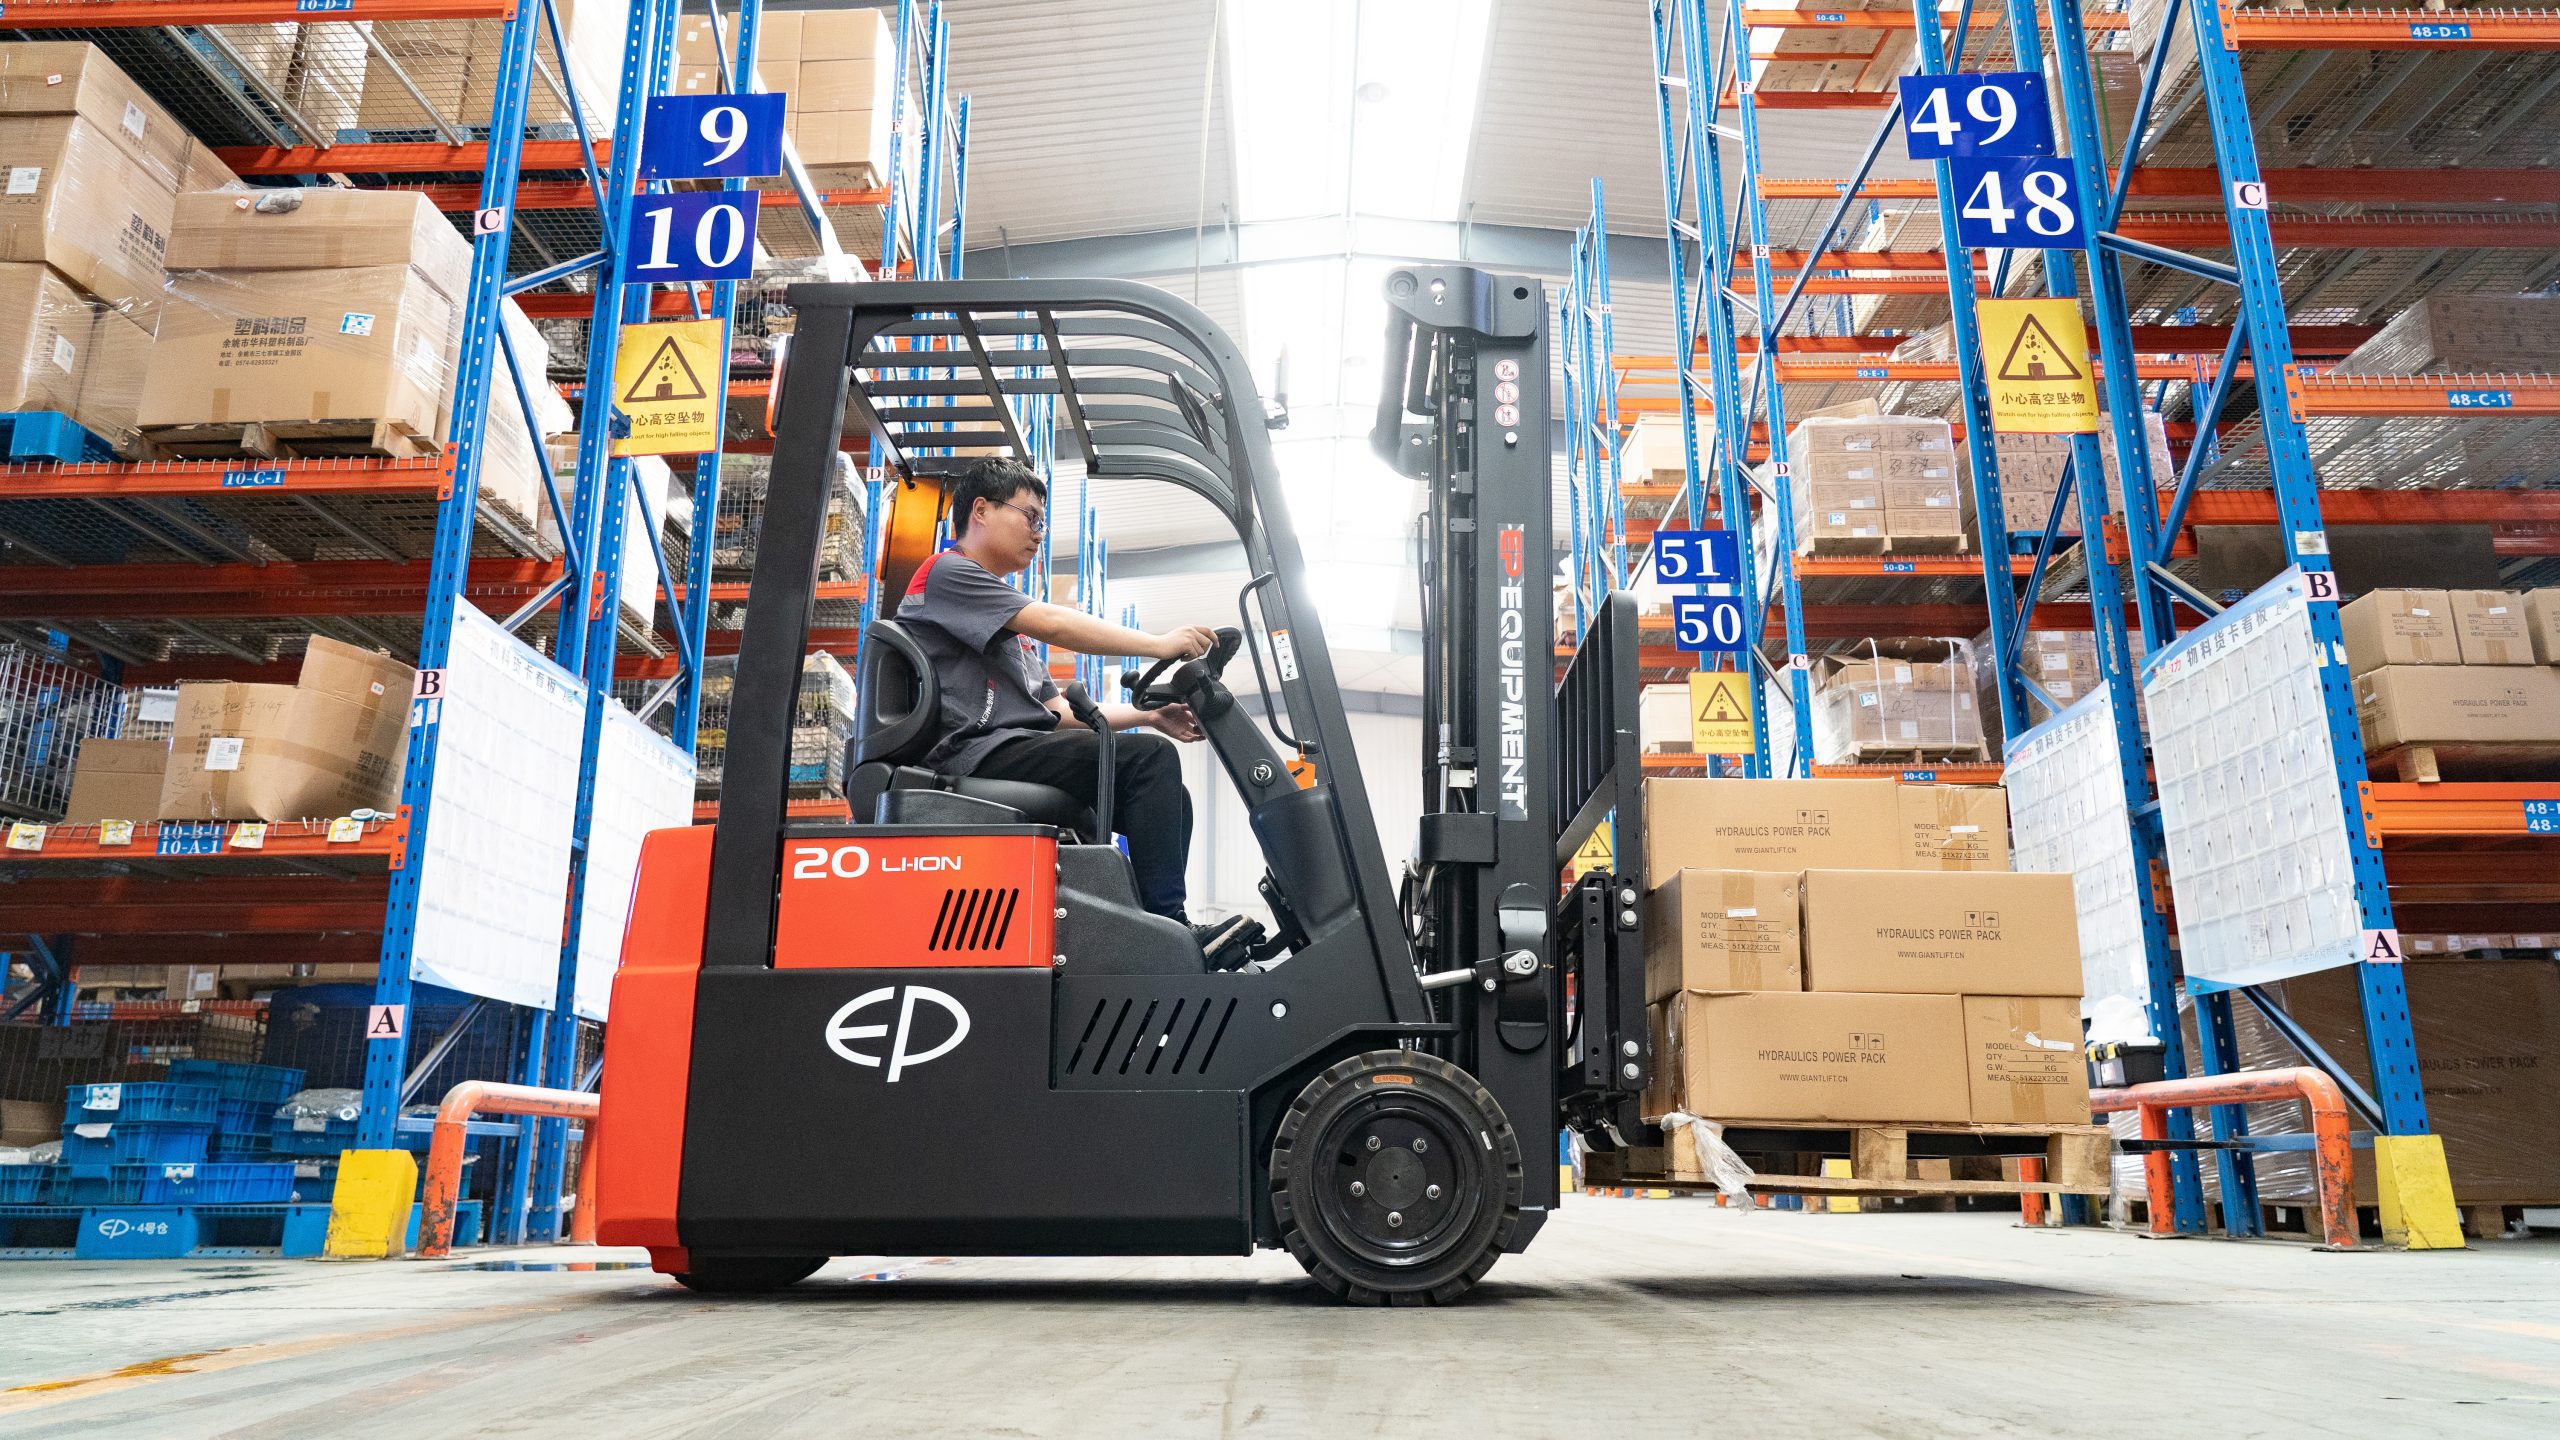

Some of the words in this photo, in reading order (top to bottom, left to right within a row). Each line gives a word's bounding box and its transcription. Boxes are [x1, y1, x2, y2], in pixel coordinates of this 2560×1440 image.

[2412, 27, 2467, 37] 48-D-1
[1740, 82, 1750, 93] F
[1909, 84, 2018, 147] 49
[700, 106, 749, 166] 9
[1962, 170, 2076, 236] 48
[2239, 185, 2261, 206] C
[480, 209, 500, 230] C
[636, 204, 745, 270] 10
[1756, 246, 1767, 257] E
[883, 268, 892, 279] E
[234, 316, 307, 336] 塑料制品
[2001, 392, 2085, 405] 小心高空坠物
[2451, 394, 2507, 406] 48-C-1
[225, 471, 281, 485] 10-C-1
[870, 468, 881, 480] D
[1776, 462, 1789, 476] D
[1500, 530, 1522, 577] EP
[1659, 538, 1720, 578] 51
[2305, 574, 2332, 598] B
[1679, 603, 1742, 644] 50
[2187, 604, 2268, 667] 物料货卡看板
[1793, 655, 1806, 668] C
[418, 671, 440, 696] B
[1500, 586, 1526, 811] EQUIPMENT
[1715, 826, 1770, 837] HYDRAULICS
[1773, 826, 1804, 836] POWER
[1807, 827, 1831, 837] PACK
[160, 840, 218, 854] 10-A-1
[793, 846, 870, 879] 20
[881, 855, 962, 872] LI-ION
[1876, 928, 1934, 939] HYDRAULICS
[1939, 929, 1972, 940] POWER
[1977, 930, 2001, 941] PACK
[2370, 931, 2398, 958] A
[1898, 951, 1965, 959] WWW.GIANTLIFT.CN
[371, 1007, 398, 1033] A
[825, 984, 971, 1082] EP
[1758, 1050, 1818, 1062] HYDRAULICS
[1822, 1051, 1857, 1062] POWER
[1861, 1052, 1886, 1064] PACK
[2509, 1056, 2538, 1068] PACK
[1779, 1074, 1848, 1083] WWW.GIANTLIFT.CN
